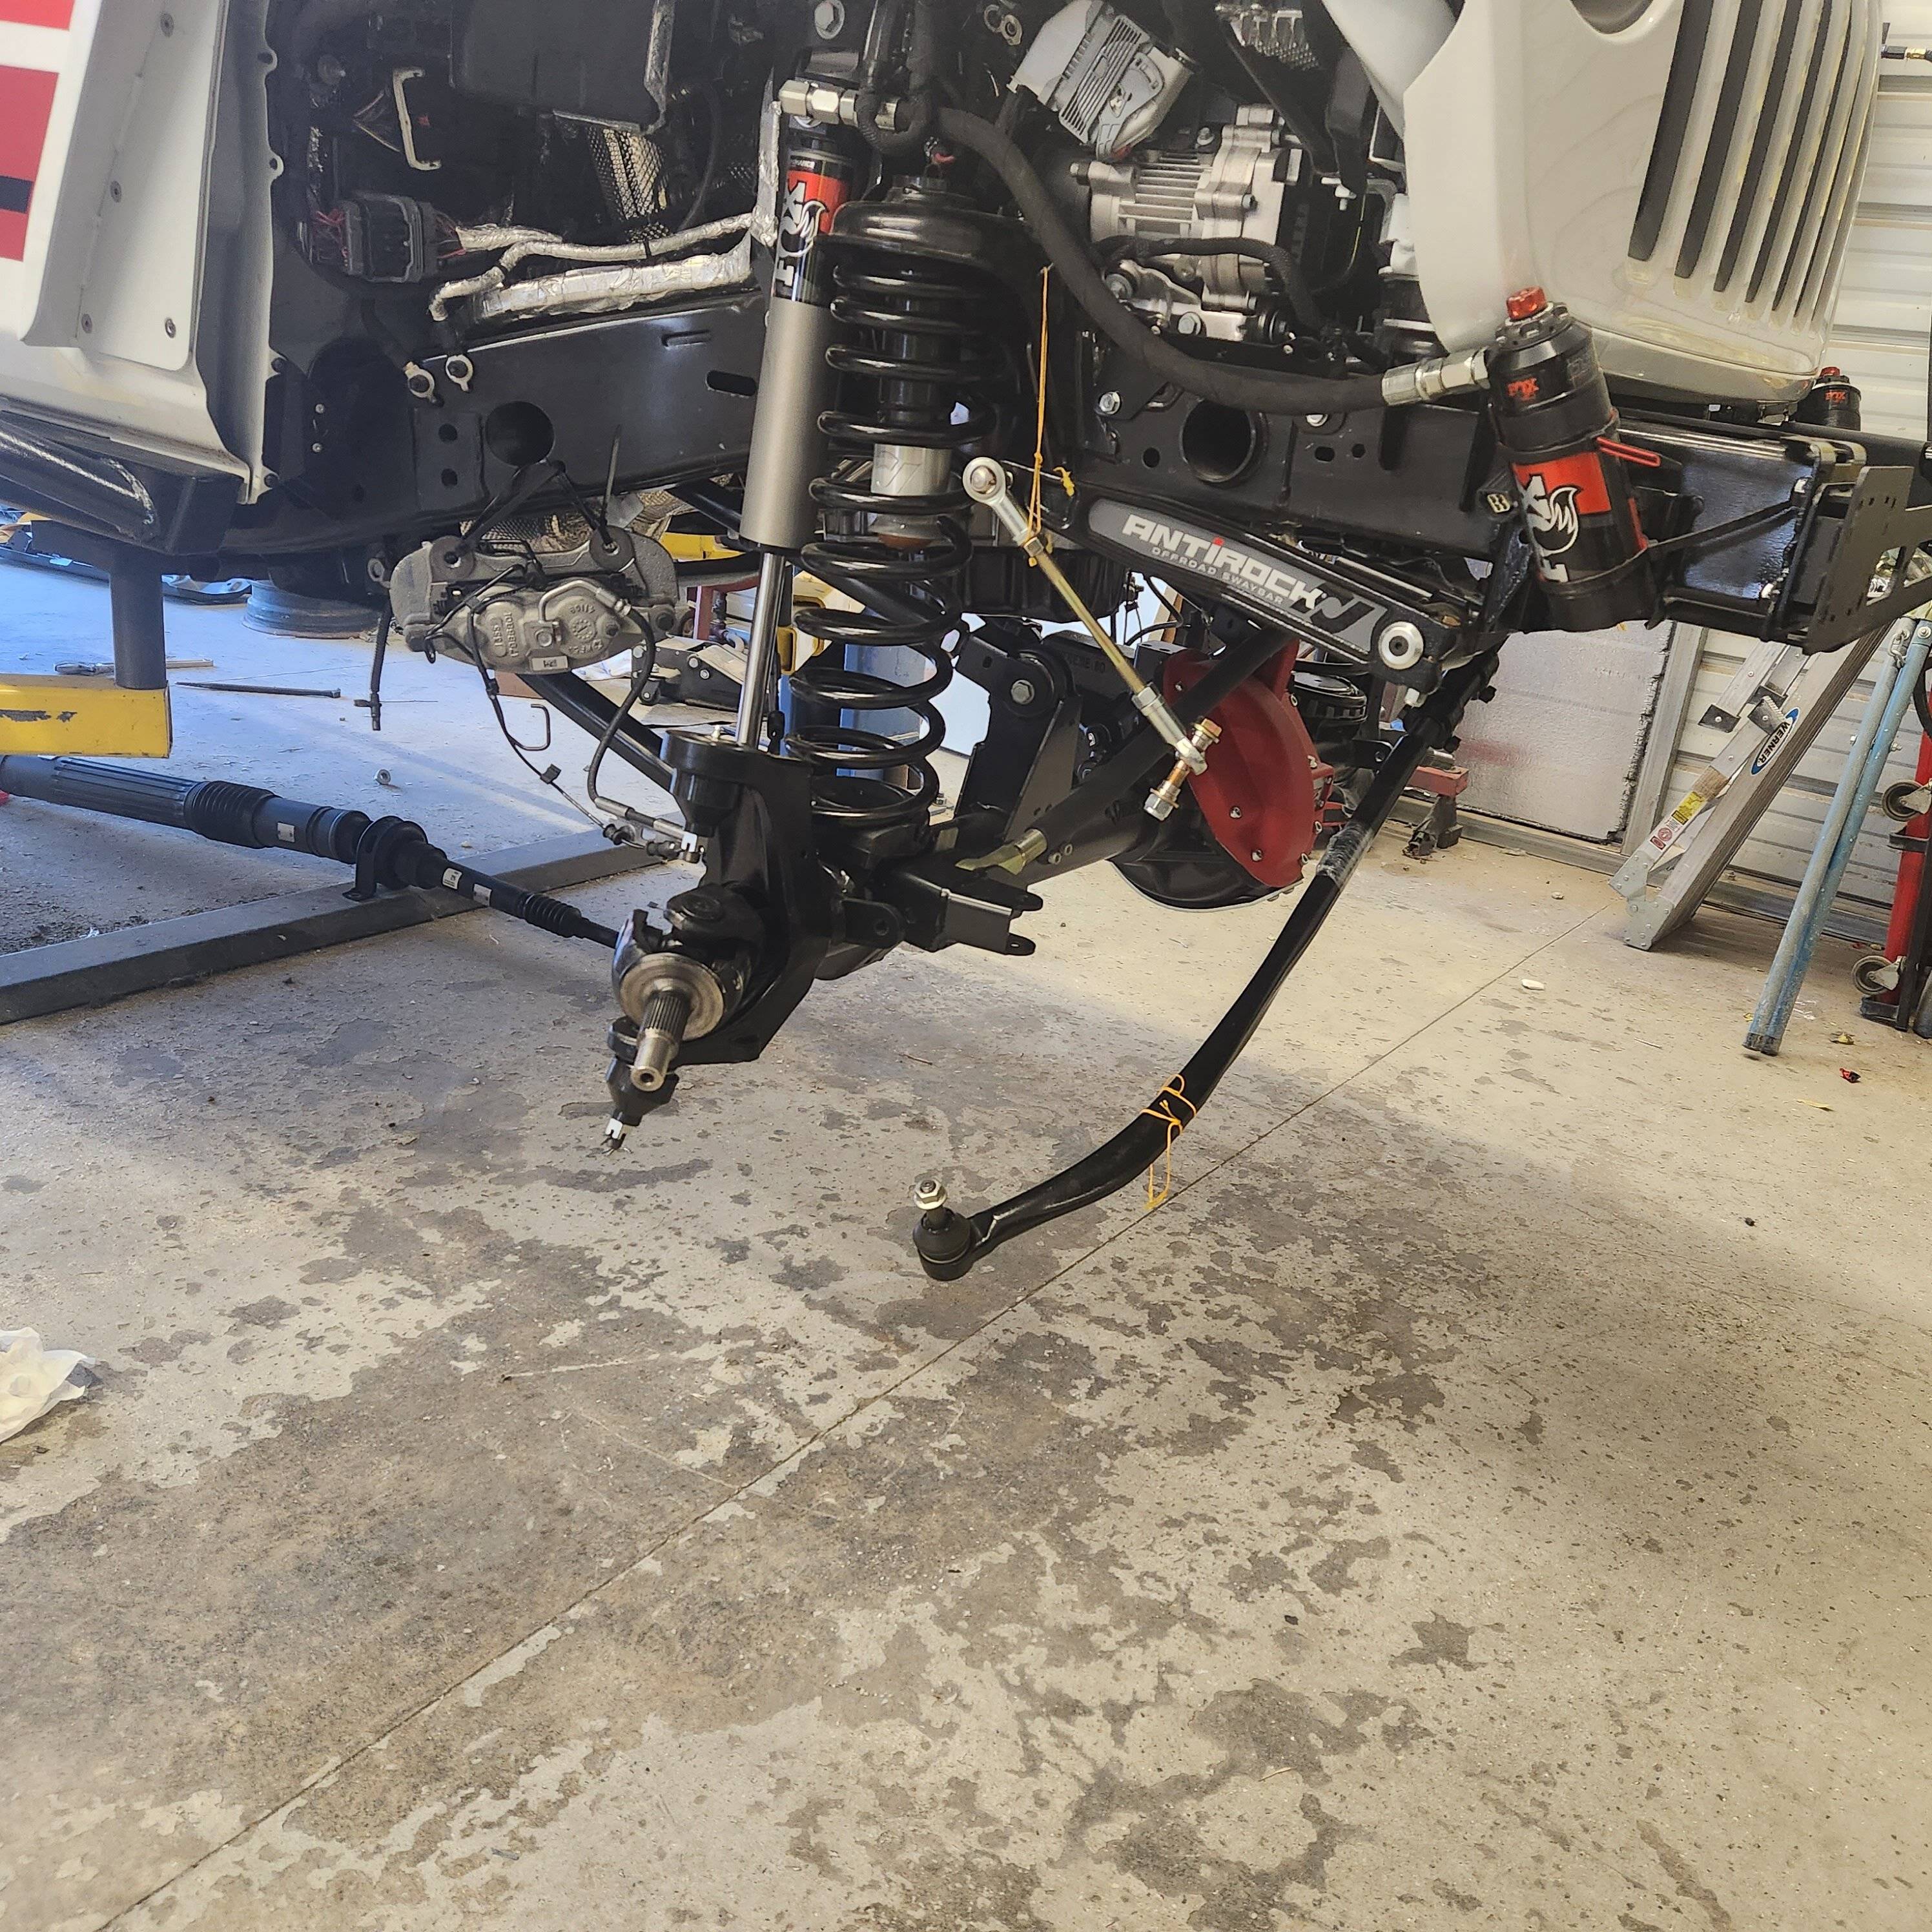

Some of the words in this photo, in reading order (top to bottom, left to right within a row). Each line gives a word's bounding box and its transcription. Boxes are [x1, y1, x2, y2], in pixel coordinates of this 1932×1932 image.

[775, 181, 827, 287] FOX
[1517, 475, 1579, 583] FOX
[1151, 546, 1217, 575] OFFROAD
[1221, 571, 1284, 606] SWAYBAR
[1758, 721, 1790, 764] WERNER
